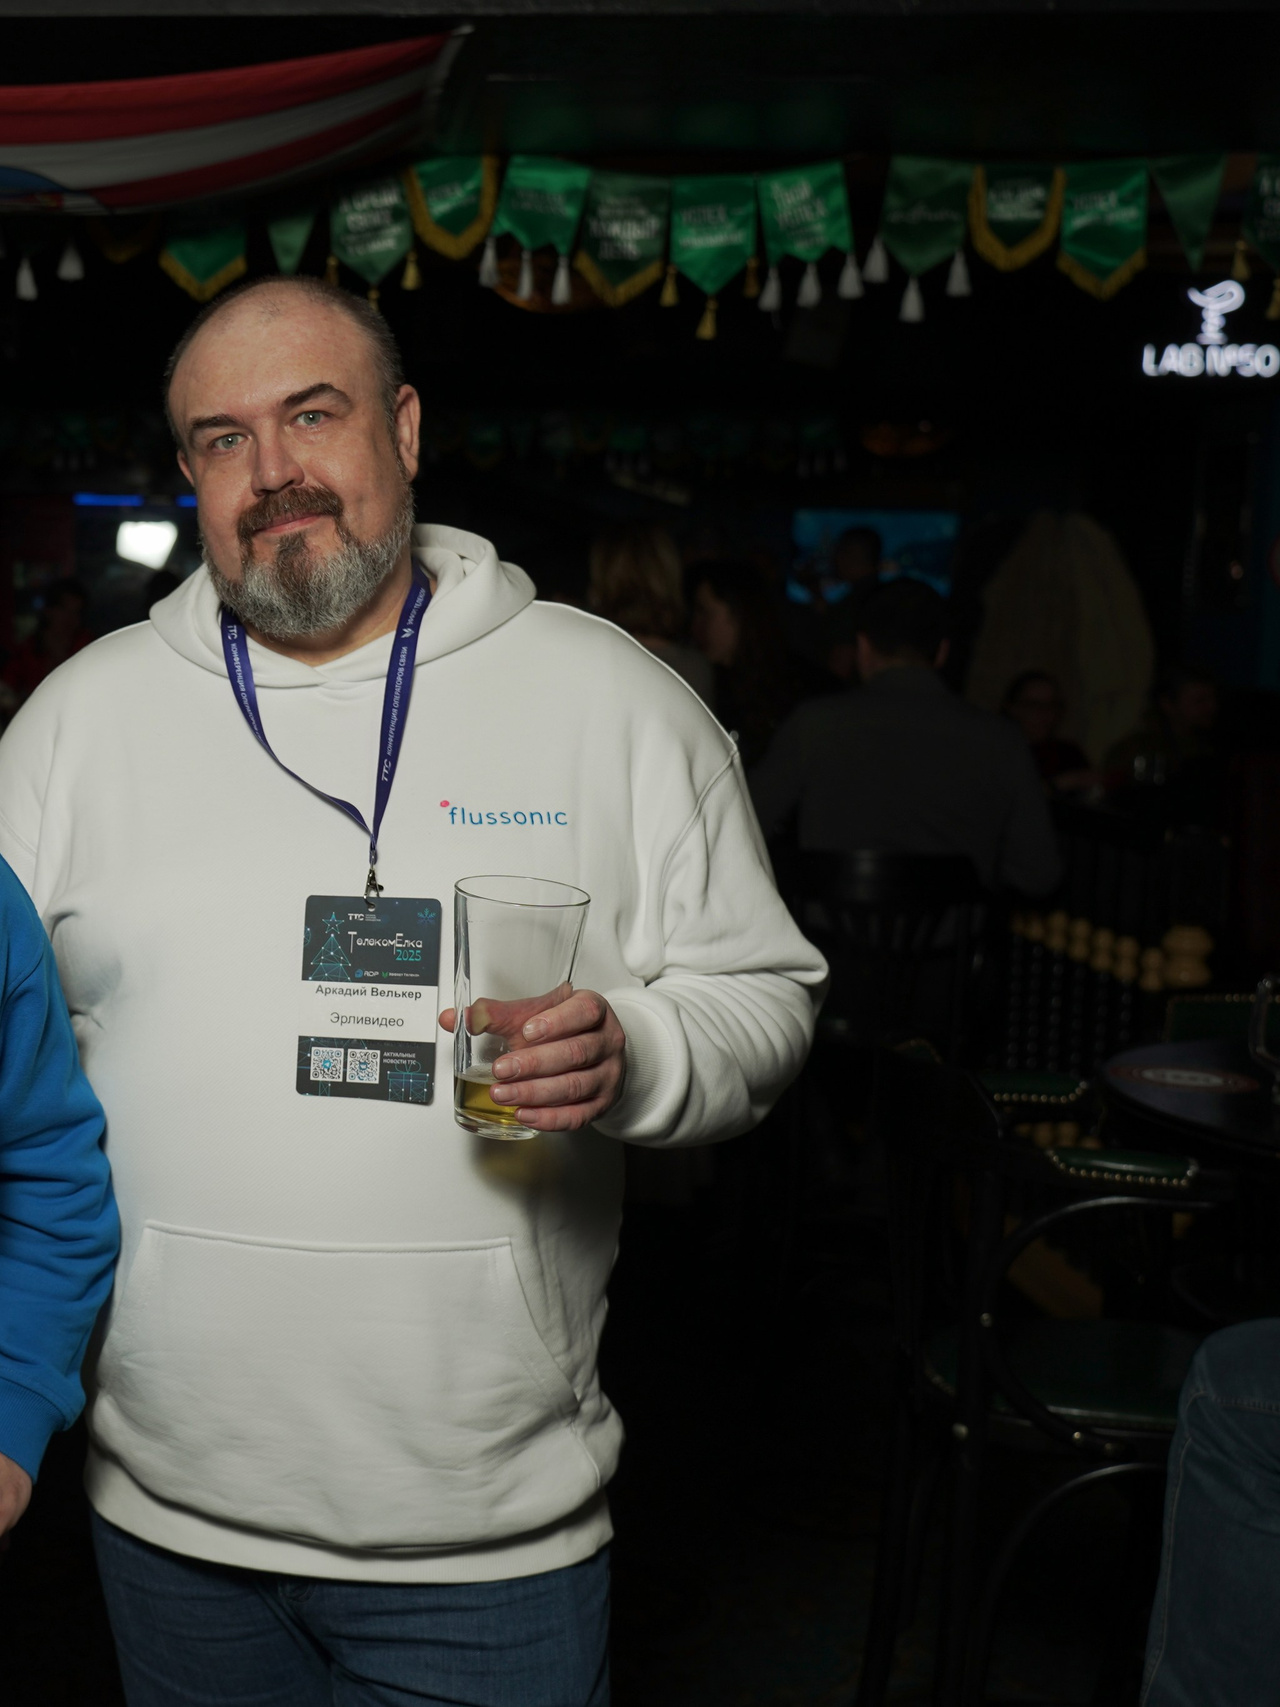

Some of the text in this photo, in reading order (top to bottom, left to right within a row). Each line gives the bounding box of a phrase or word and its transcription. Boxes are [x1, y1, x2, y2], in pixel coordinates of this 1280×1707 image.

[398, 645, 409, 667] СВЯЗИ
[230, 642, 247, 692] КОНФЕРЕНЦИЯ
[393, 667, 406, 708] ОПЕРАТОРОВ
[386, 708, 400, 757] КОНФЕРЕНЦИЯ
[449, 806, 568, 826] flussonic
[395, 949, 422, 962] 2025
[315, 984, 422, 1001] Аркадий Велькер
[330, 1011, 404, 1027] Эрливидео
